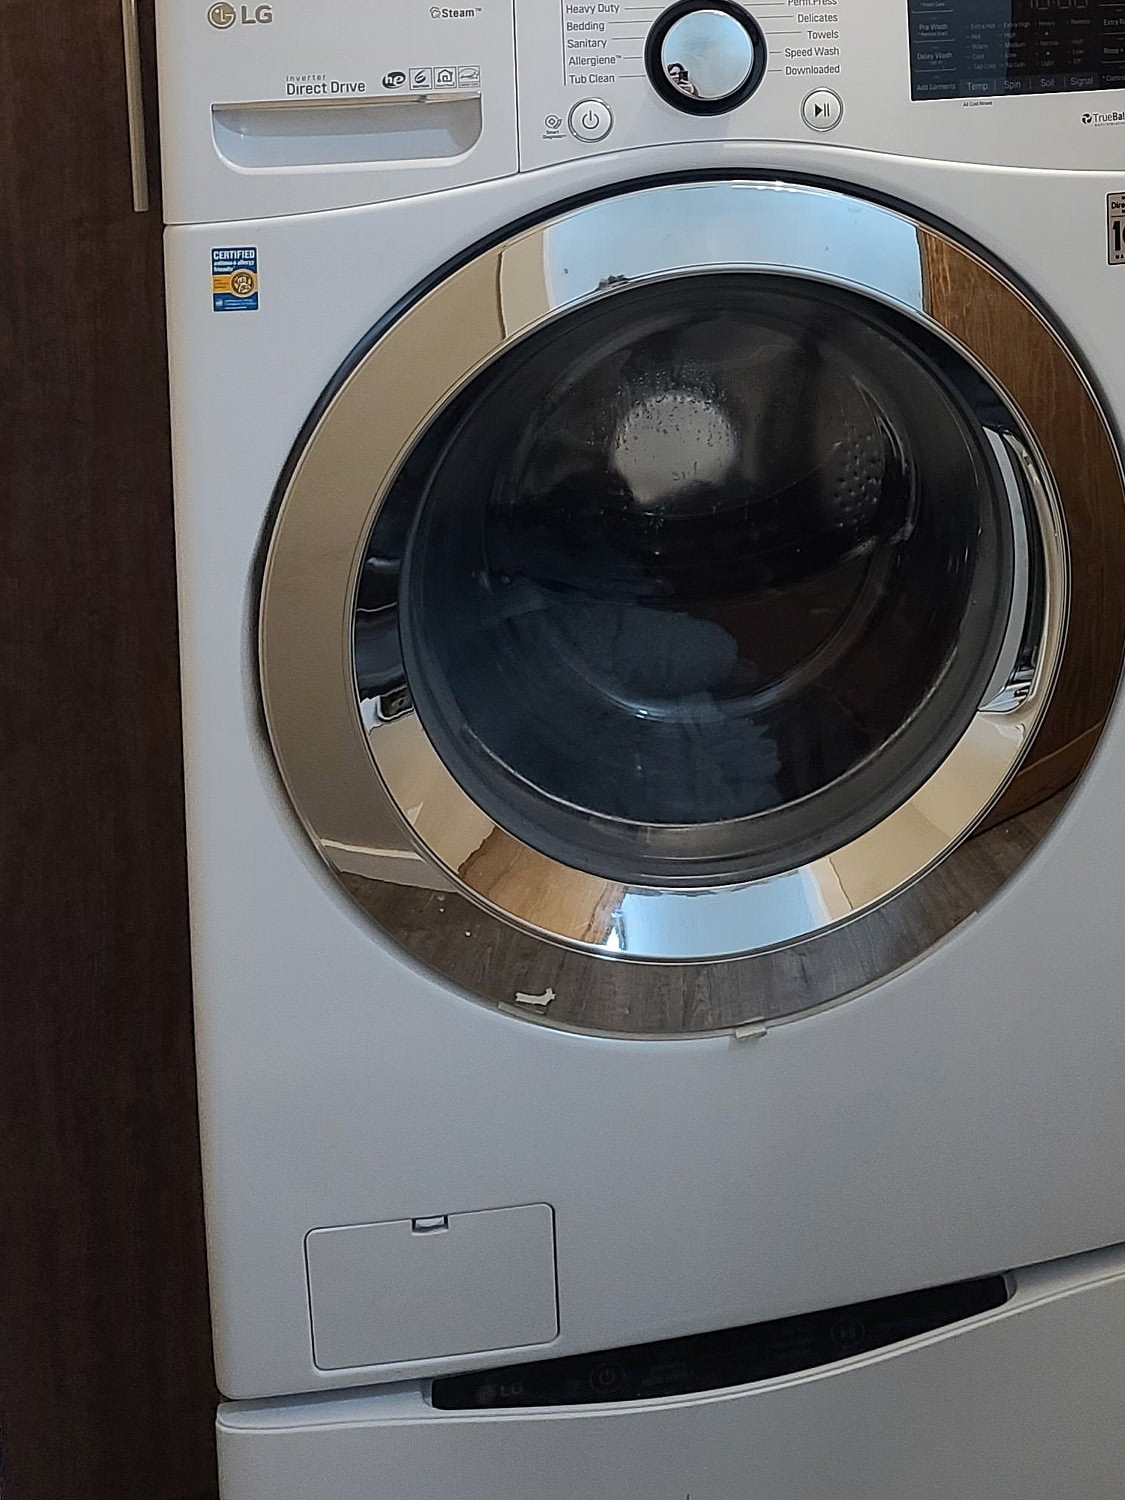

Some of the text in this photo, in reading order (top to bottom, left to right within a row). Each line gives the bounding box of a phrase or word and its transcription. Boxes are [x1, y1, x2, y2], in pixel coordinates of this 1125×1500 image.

[241, 5, 273, 24] LG
[566, 3, 620, 15] Heavy Duty
[797, 12, 838, 23] Delicates
[566, 21, 605, 32] Bedding
[806, 29, 839, 40] Towels
[567, 38, 607, 49] Sanitary
[784, 46, 840, 59] Speed Wash
[785, 64, 840, 76] Downloaded
[569, 73, 615, 84] Tub Clean
[1040, 77, 1055, 88] Soil
[1070, 76, 1095, 87] Signal
[286, 80, 366, 95] Direct Drive
[967, 82, 989, 92] Temp
[1003, 79, 1022, 90] Spin
[213, 250, 255, 260] CERTIFIED
